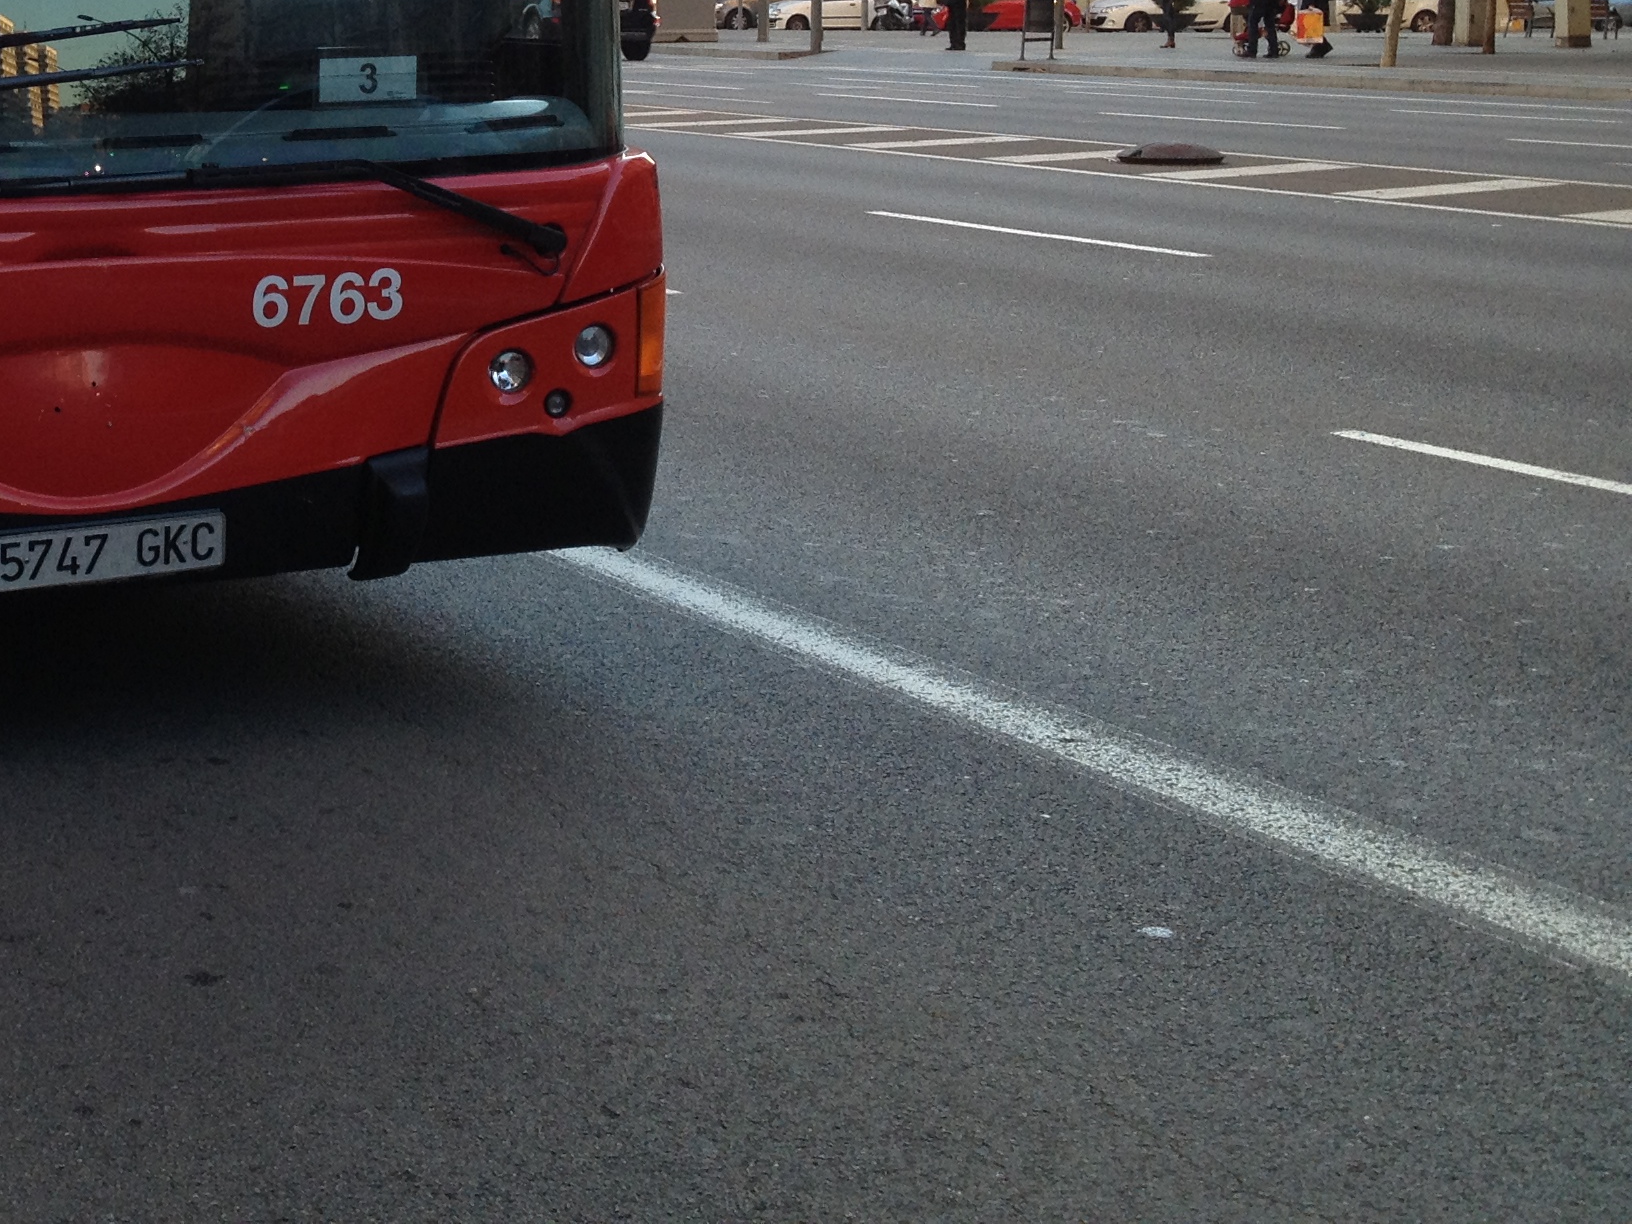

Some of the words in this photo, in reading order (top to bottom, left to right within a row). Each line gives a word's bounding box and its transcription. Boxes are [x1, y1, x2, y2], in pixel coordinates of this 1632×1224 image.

[358, 62, 378, 94] 3
[252, 267, 403, 328] 6763
[0, 533, 109, 582] 5747
[136, 522, 215, 567] GKC
